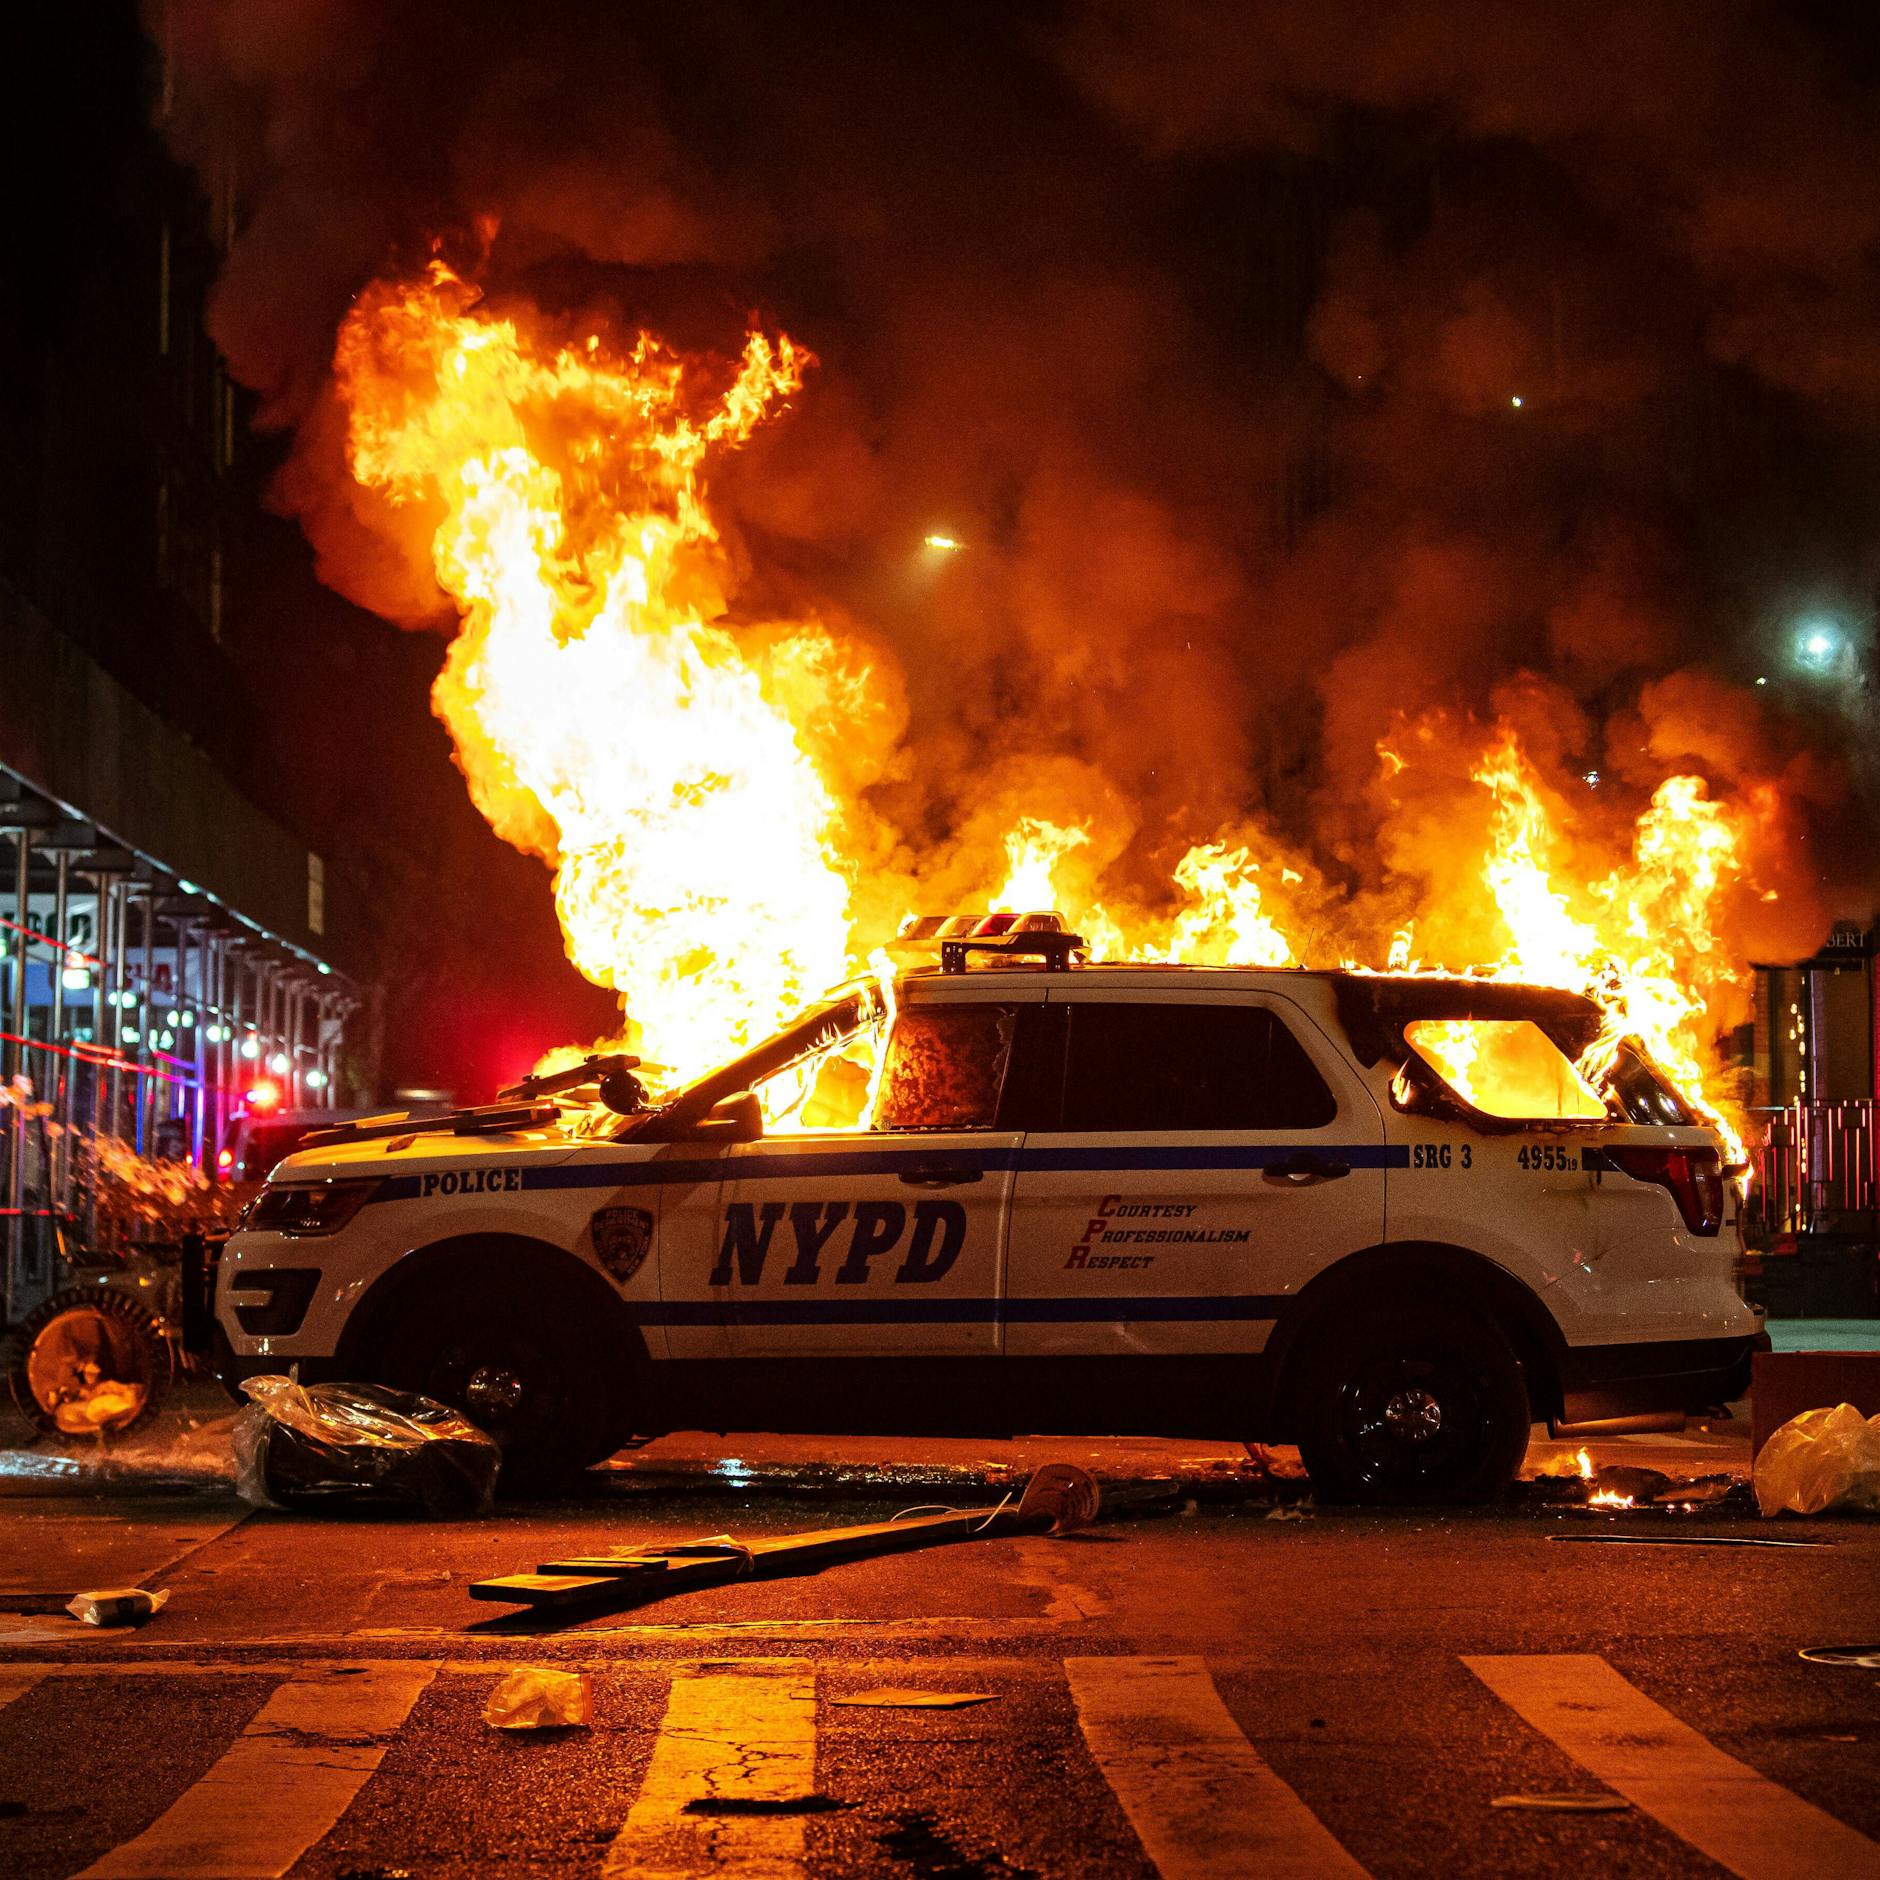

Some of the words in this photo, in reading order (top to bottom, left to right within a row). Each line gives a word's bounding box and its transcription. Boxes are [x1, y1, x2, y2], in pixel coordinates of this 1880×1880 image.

[1413, 1144, 1451, 1169] SRG
[1461, 1144, 1472, 1169] 3
[423, 1169, 519, 1197] POLICE
[708, 1201, 966, 1285] NYPD
